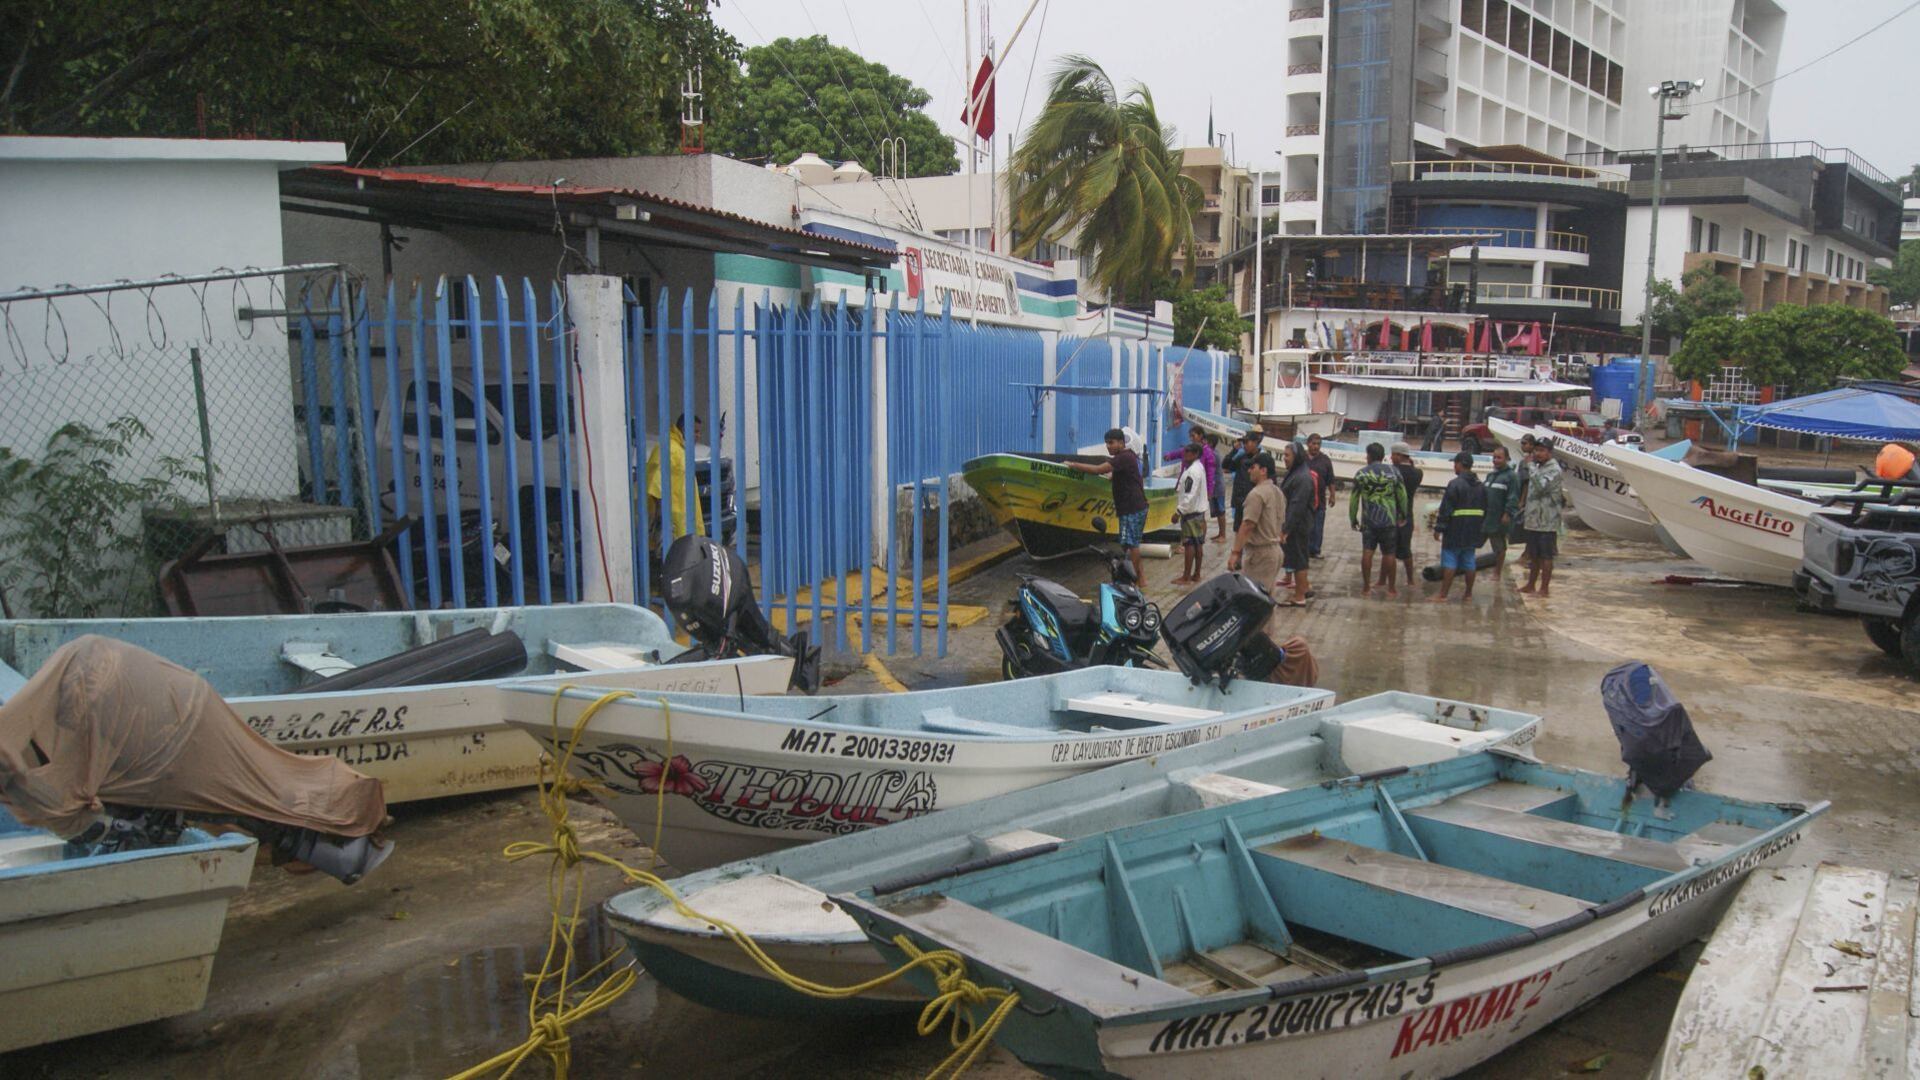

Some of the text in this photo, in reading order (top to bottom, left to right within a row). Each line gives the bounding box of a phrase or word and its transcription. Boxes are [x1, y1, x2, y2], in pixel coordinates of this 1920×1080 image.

[709, 543, 721, 596] SUZUKI
[1196, 615, 1238, 651] SUZUKI
[780, 728, 956, 764] MAT. 20013389131
[1124, 737, 1136, 756] DE
[1136, 734, 1164, 755] PUERTO
